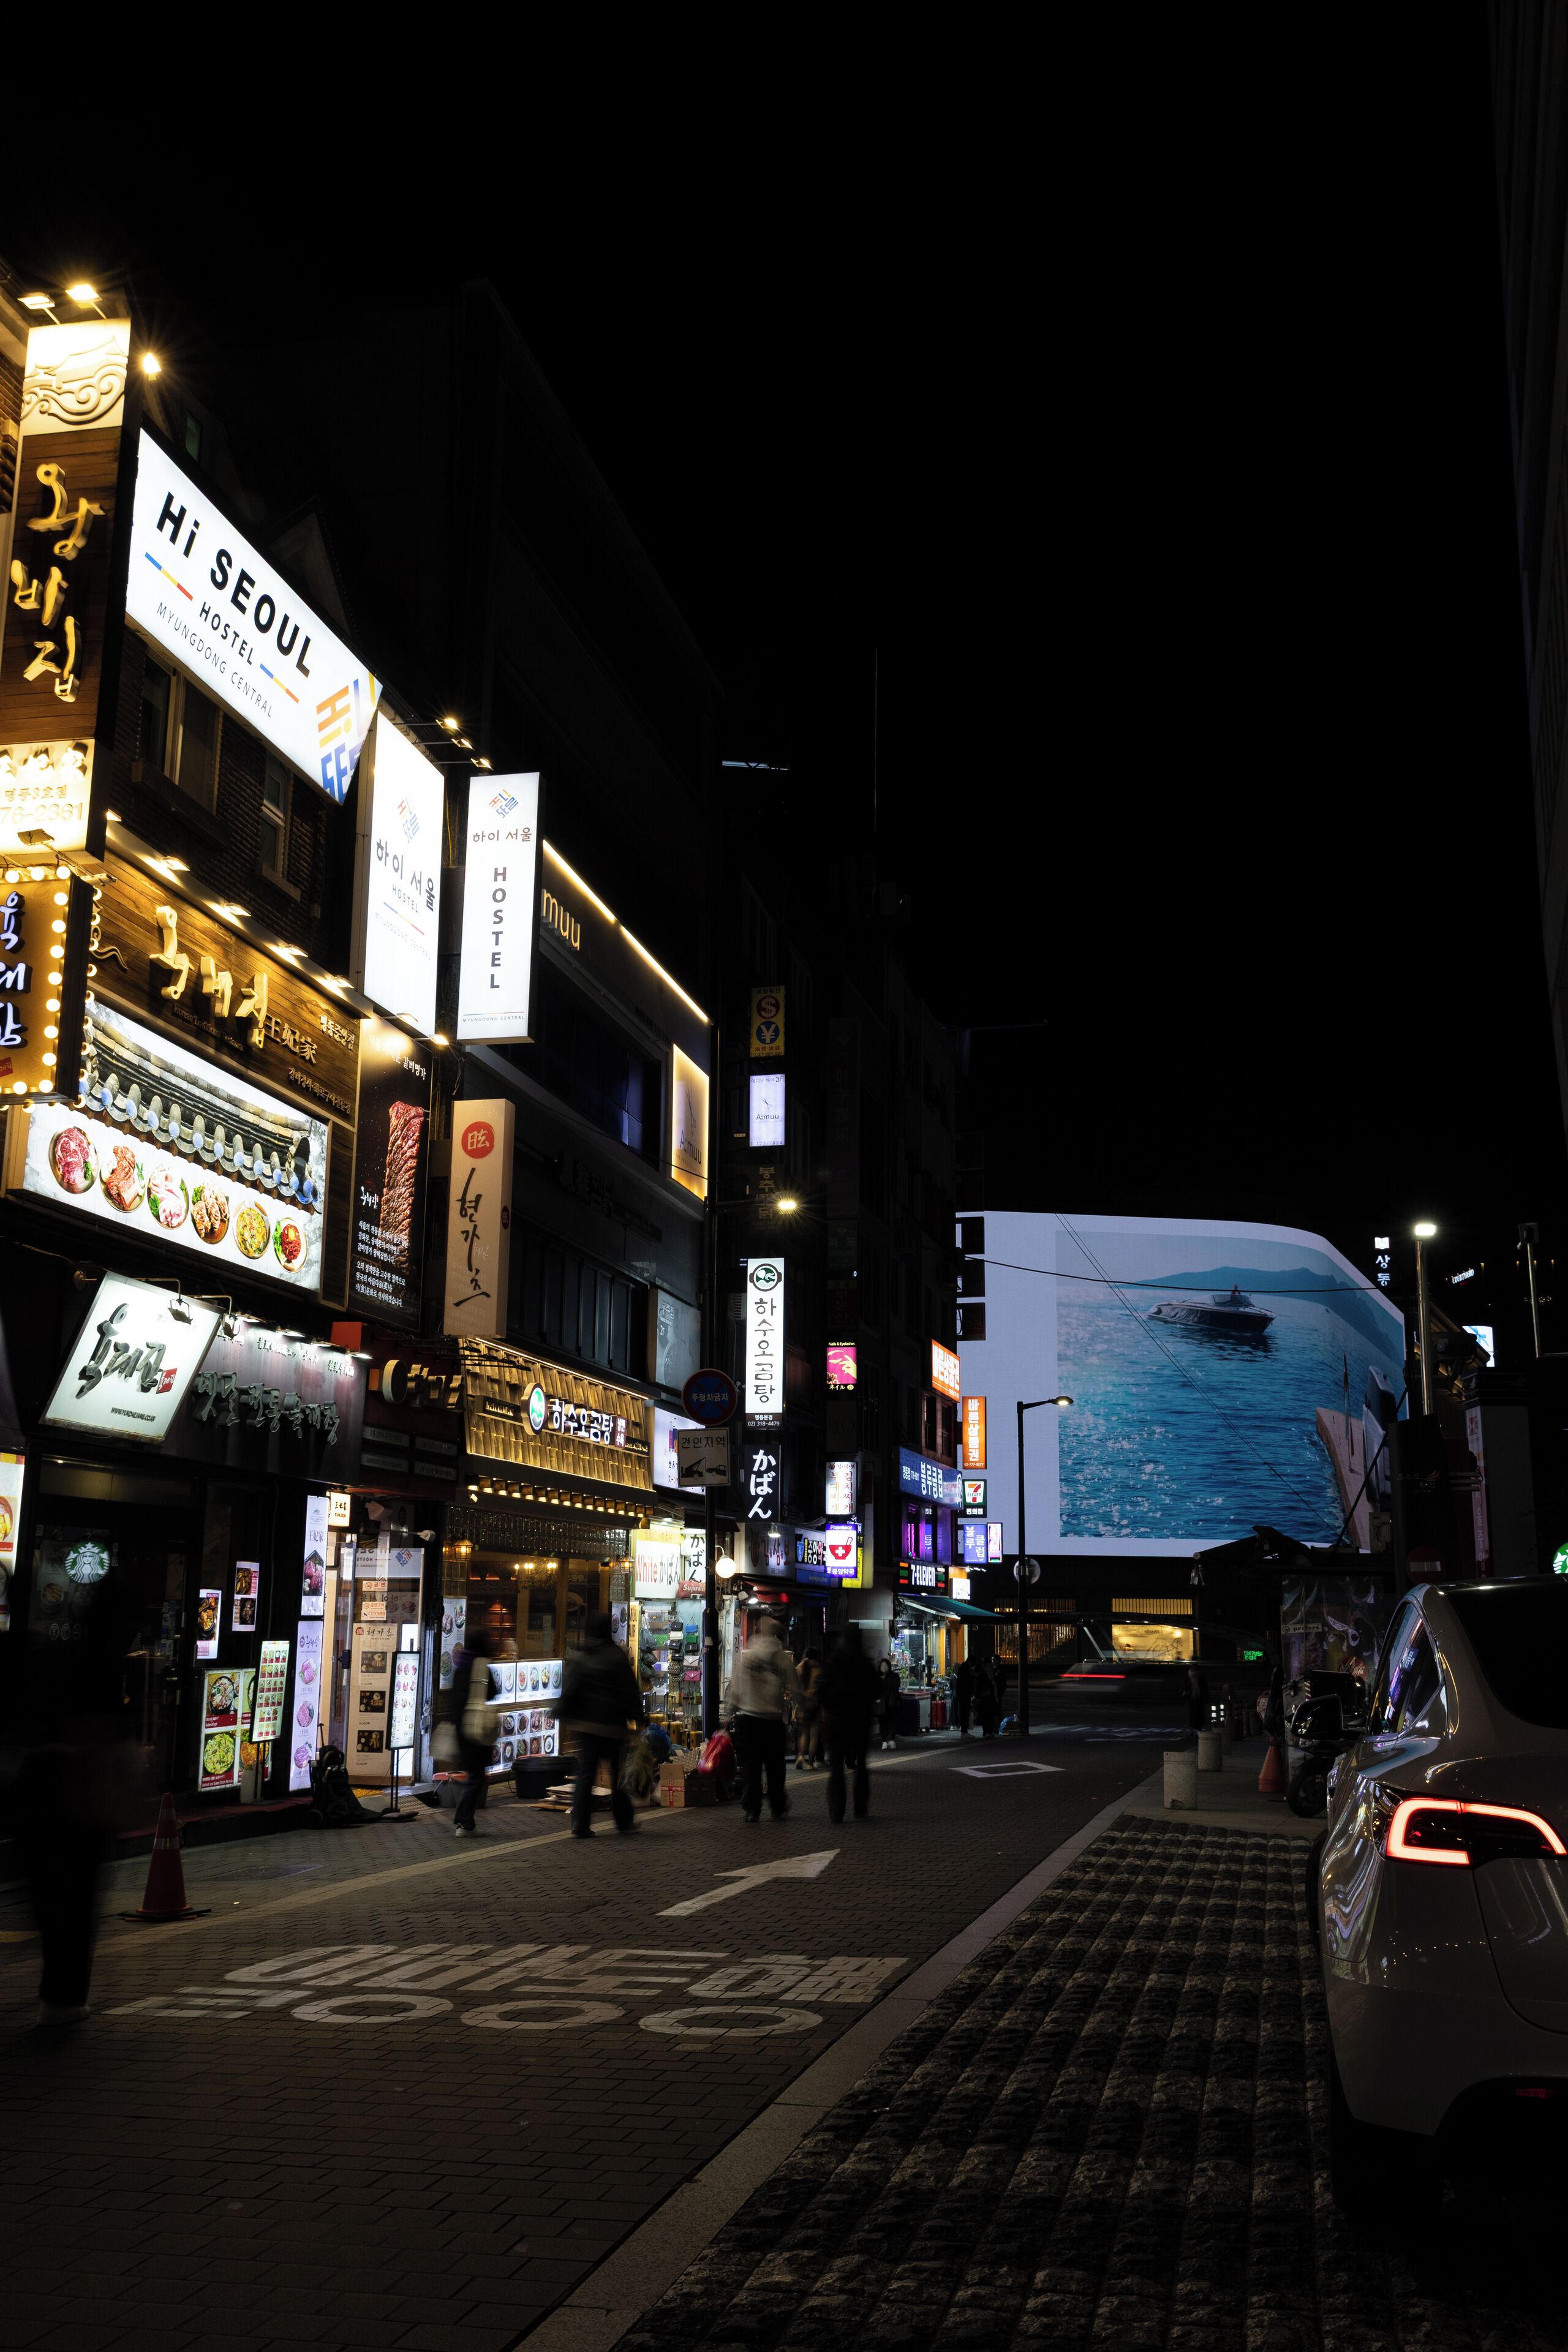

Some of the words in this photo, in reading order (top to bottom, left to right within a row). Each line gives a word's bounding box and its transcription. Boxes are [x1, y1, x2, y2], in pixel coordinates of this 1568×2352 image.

[156, 491, 200, 559] Hi
[211, 549, 311, 678] SEOUL
[198, 600, 254, 666] HOSTEL
[157, 601, 226, 674] MYUNGDONG
[231, 672, 273, 719] CENTRAL
[472, 830, 499, 842] 하이
[505, 827, 532, 842] 서울
[376, 839, 403, 881] 하이
[410, 870, 434, 912] 서울
[392, 884, 419, 914] HOSTEL
[375, 912, 407, 943] MYUNGDONG
[410, 938, 431, 961] CENTRAL
[489, 867, 507, 989] HOSTEL
[403, 1056, 427, 1080] 갈비명가
[358, 1243, 372, 1256] 갈비명가
[453, 1168, 491, 1307] 현가츠
[754, 1298, 777, 1403] 하수오곰탕
[690, 1392, 729, 1403] 주정차금지
[547, 1398, 614, 1446] 하수오곰탕
[681, 1436, 726, 1449] 견인지역
[968, 1399, 980, 1461] 바른상품권
[748, 1449, 777, 1520] かばん
[829, 1472, 840, 1512] 부대찌개
[843, 1471, 853, 1513] 김치찌개
[921, 1461, 943, 1499] 블루클럽
[636, 1555, 657, 1583] White
[659, 1553, 680, 1586] かばん
[682, 1583, 706, 1593] Suprem
[367, 1627, 394, 1637] 현가츠
